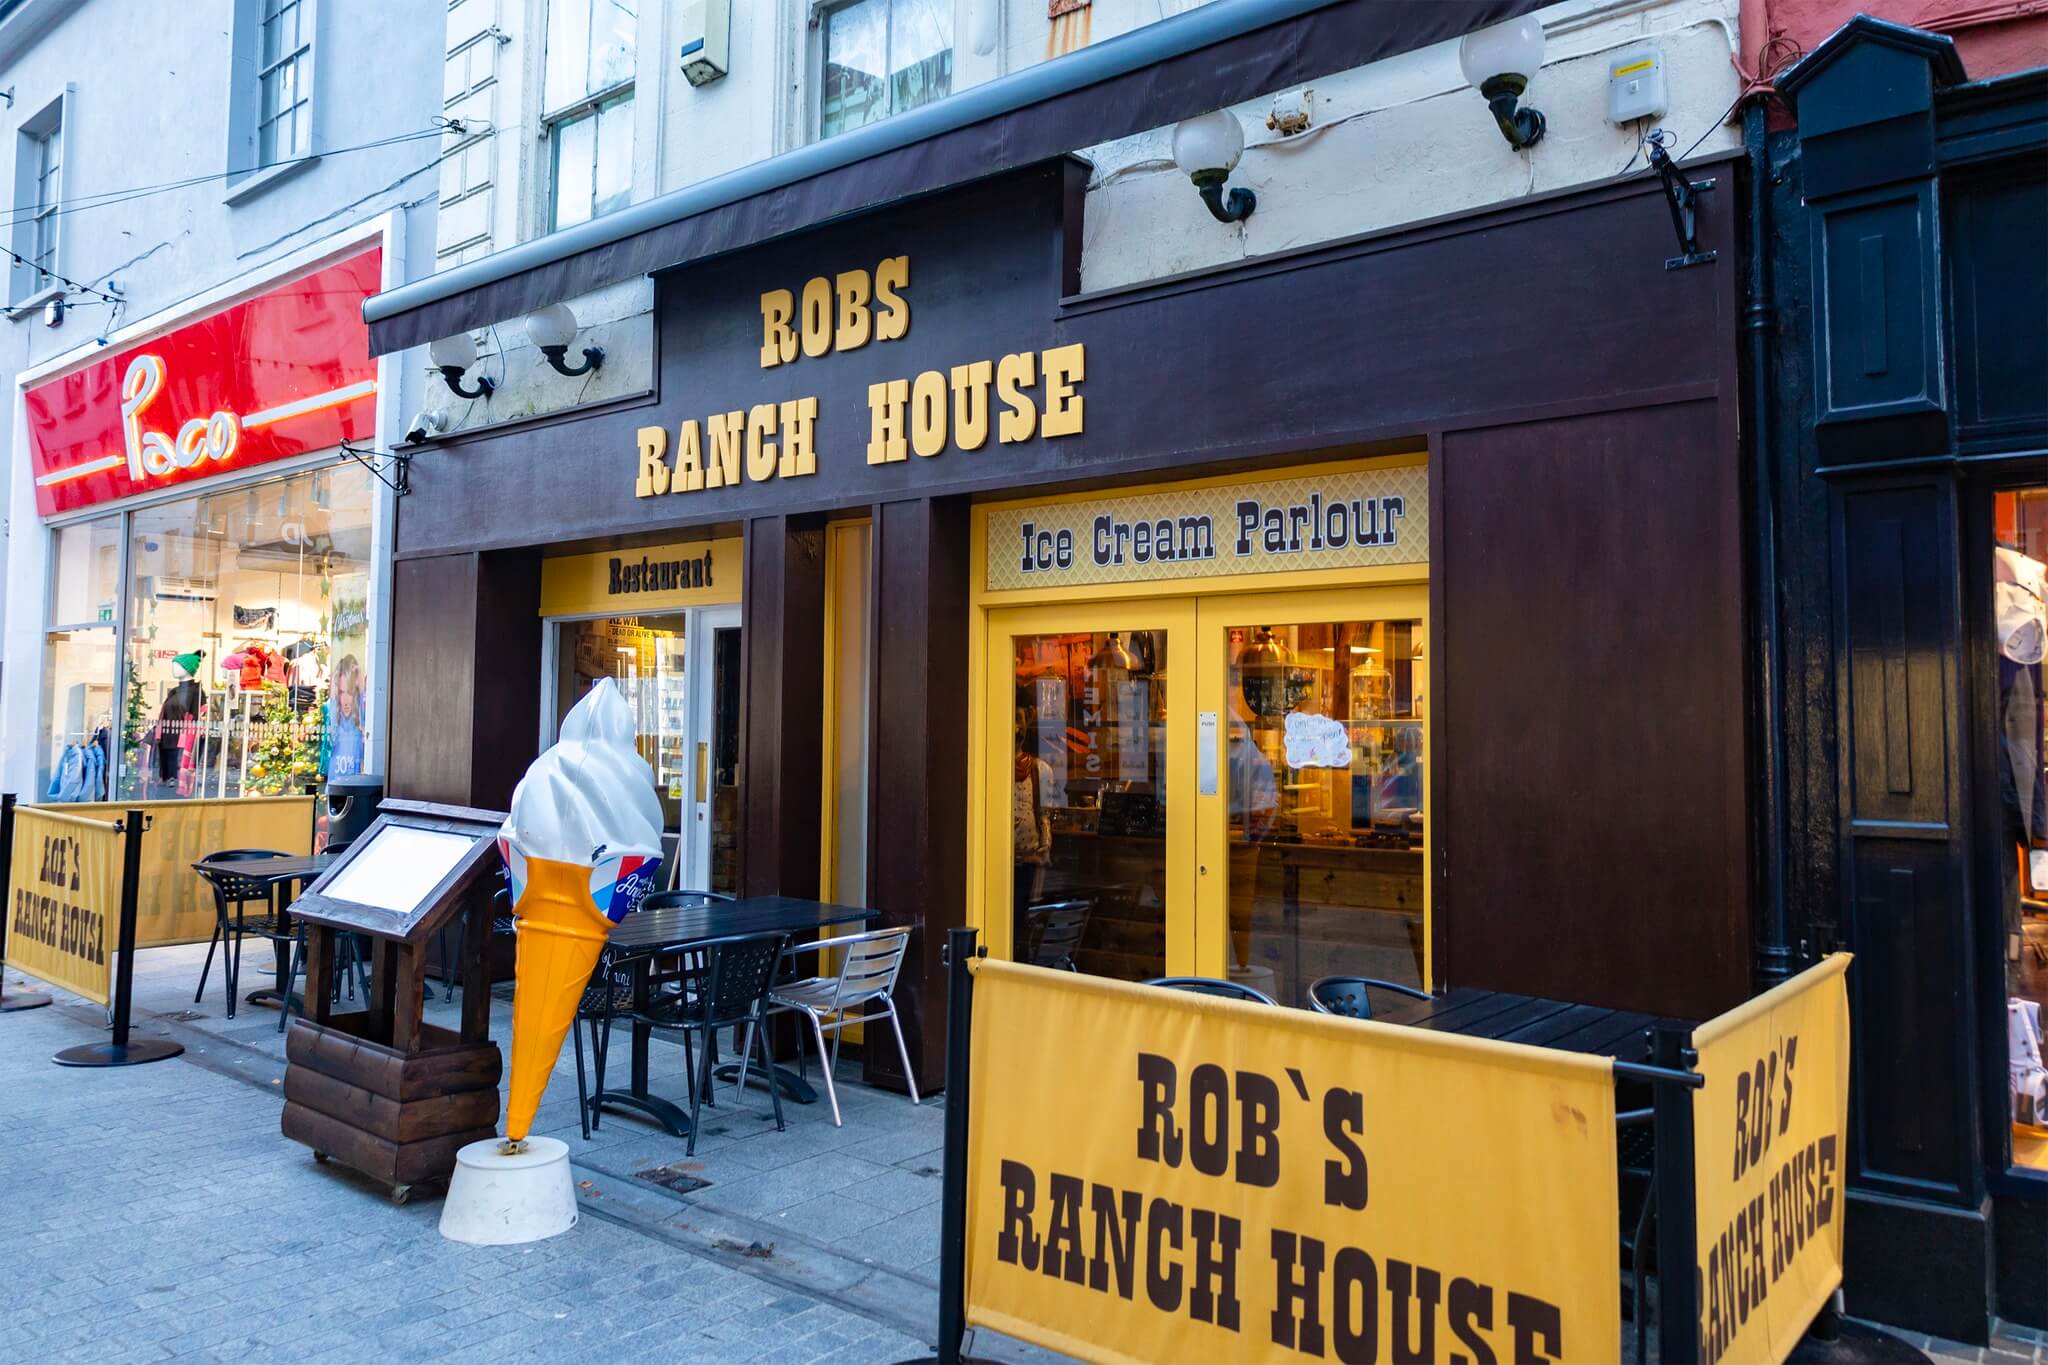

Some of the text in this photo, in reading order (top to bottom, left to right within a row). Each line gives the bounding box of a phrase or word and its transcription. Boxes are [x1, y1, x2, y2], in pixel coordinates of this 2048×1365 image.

[760, 255, 910, 369] ROBS
[121, 354, 240, 481] Paco
[635, 343, 1086, 498] RANCH HOUSE
[608, 549, 713, 595] Restaurant
[1020, 492, 1406, 574] Ice Cream Parlour
[997, 1159, 1562, 1365] RANCH HOUSE
[1769, 1134, 1837, 1284] HOUSE
